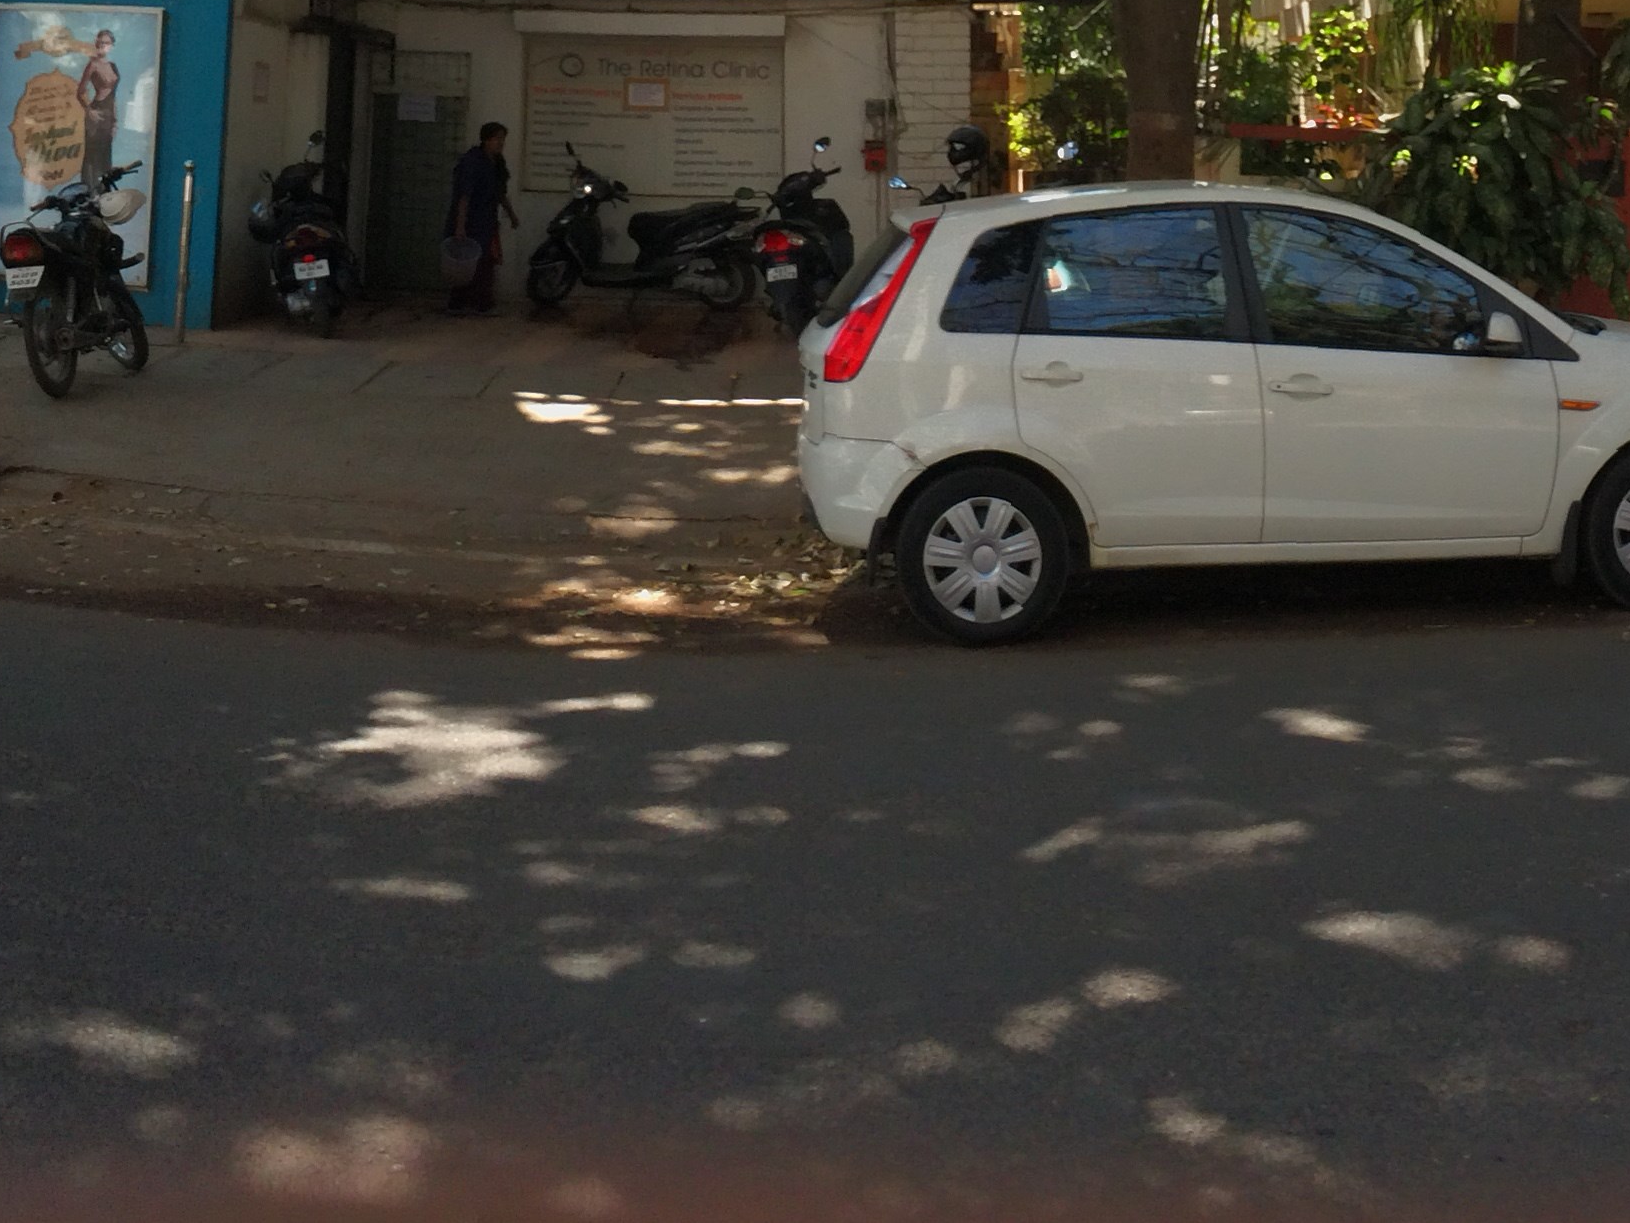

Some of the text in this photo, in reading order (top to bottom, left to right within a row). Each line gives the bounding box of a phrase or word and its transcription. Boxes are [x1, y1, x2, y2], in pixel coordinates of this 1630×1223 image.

[598, 58, 771, 80] The Retina Clinic
